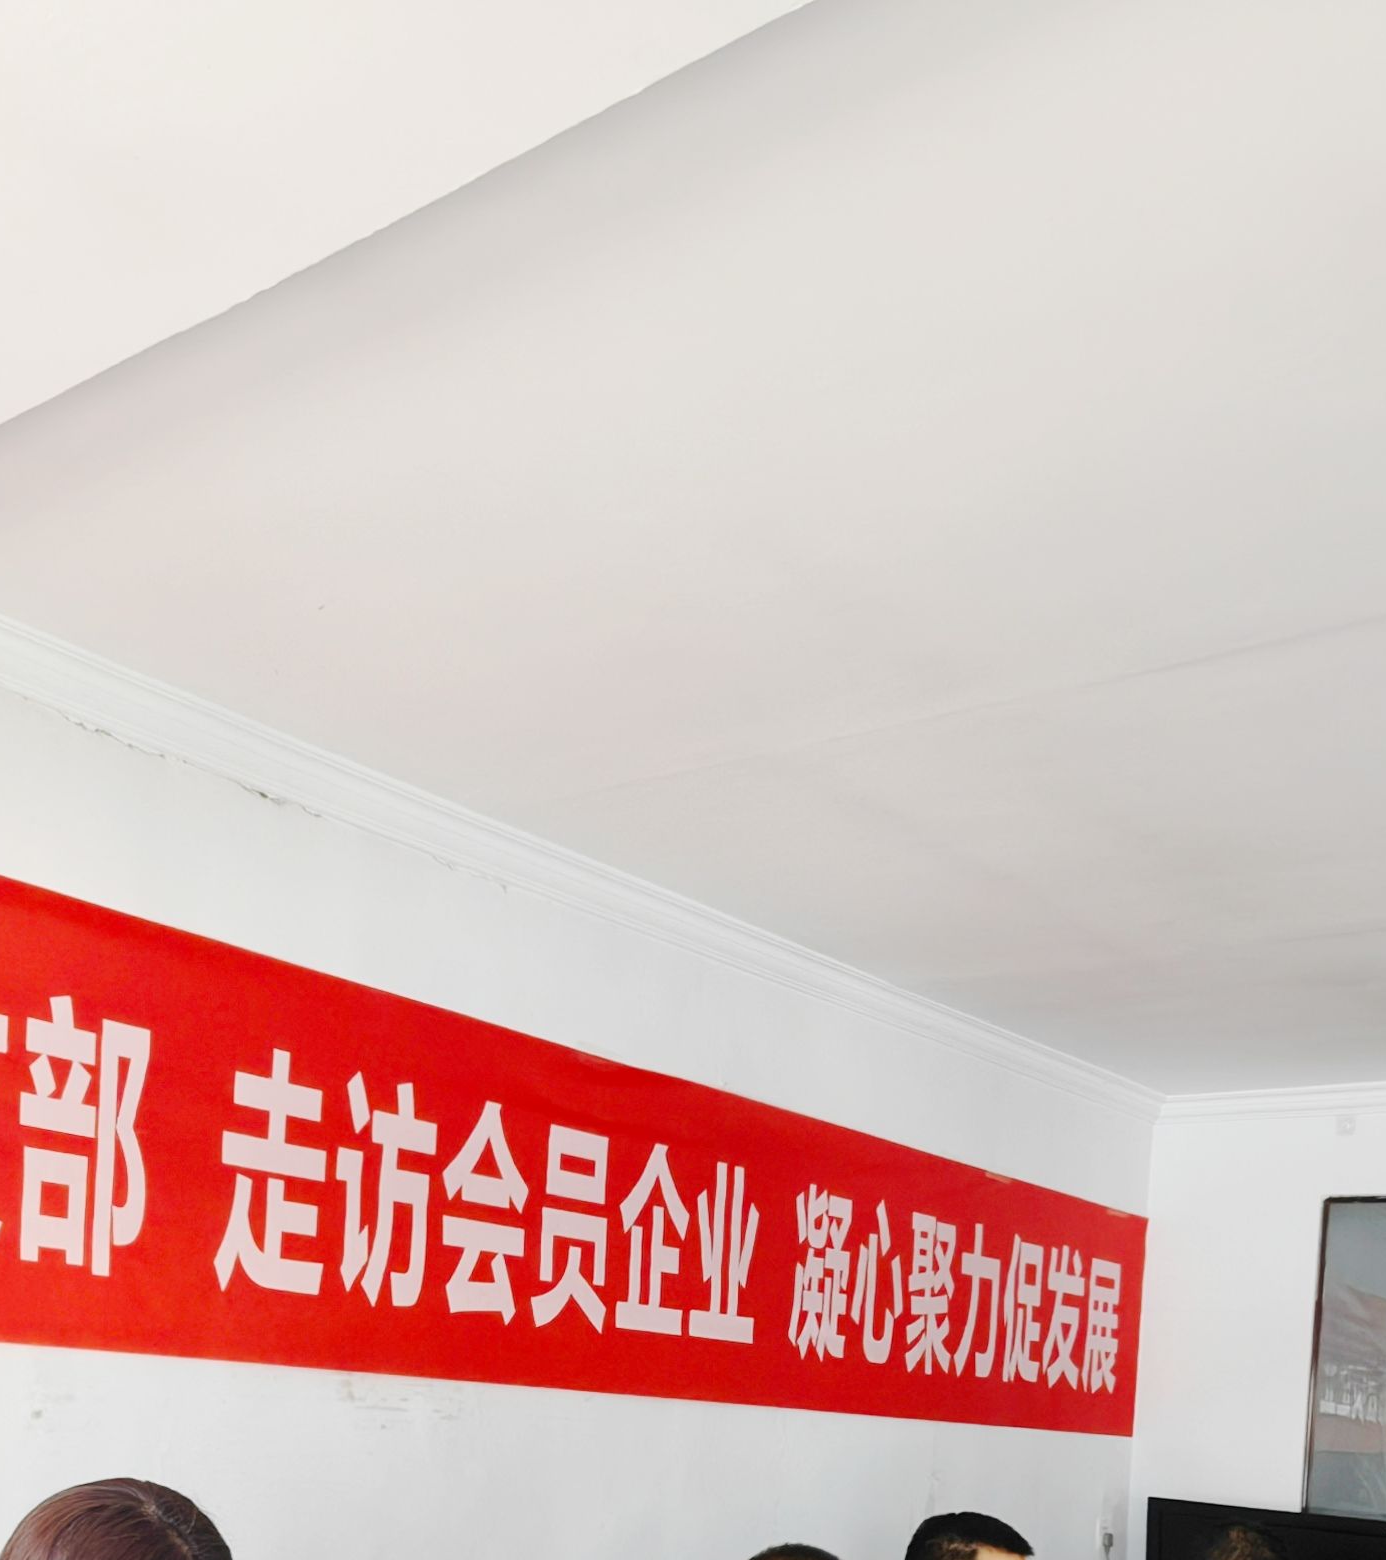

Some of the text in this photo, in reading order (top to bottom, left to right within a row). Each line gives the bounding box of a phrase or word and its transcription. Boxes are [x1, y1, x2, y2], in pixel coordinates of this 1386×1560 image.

[215, 1047, 759, 1345] 走访会员企业
[788, 1182, 1122, 1394] 凝心聚力促发展
